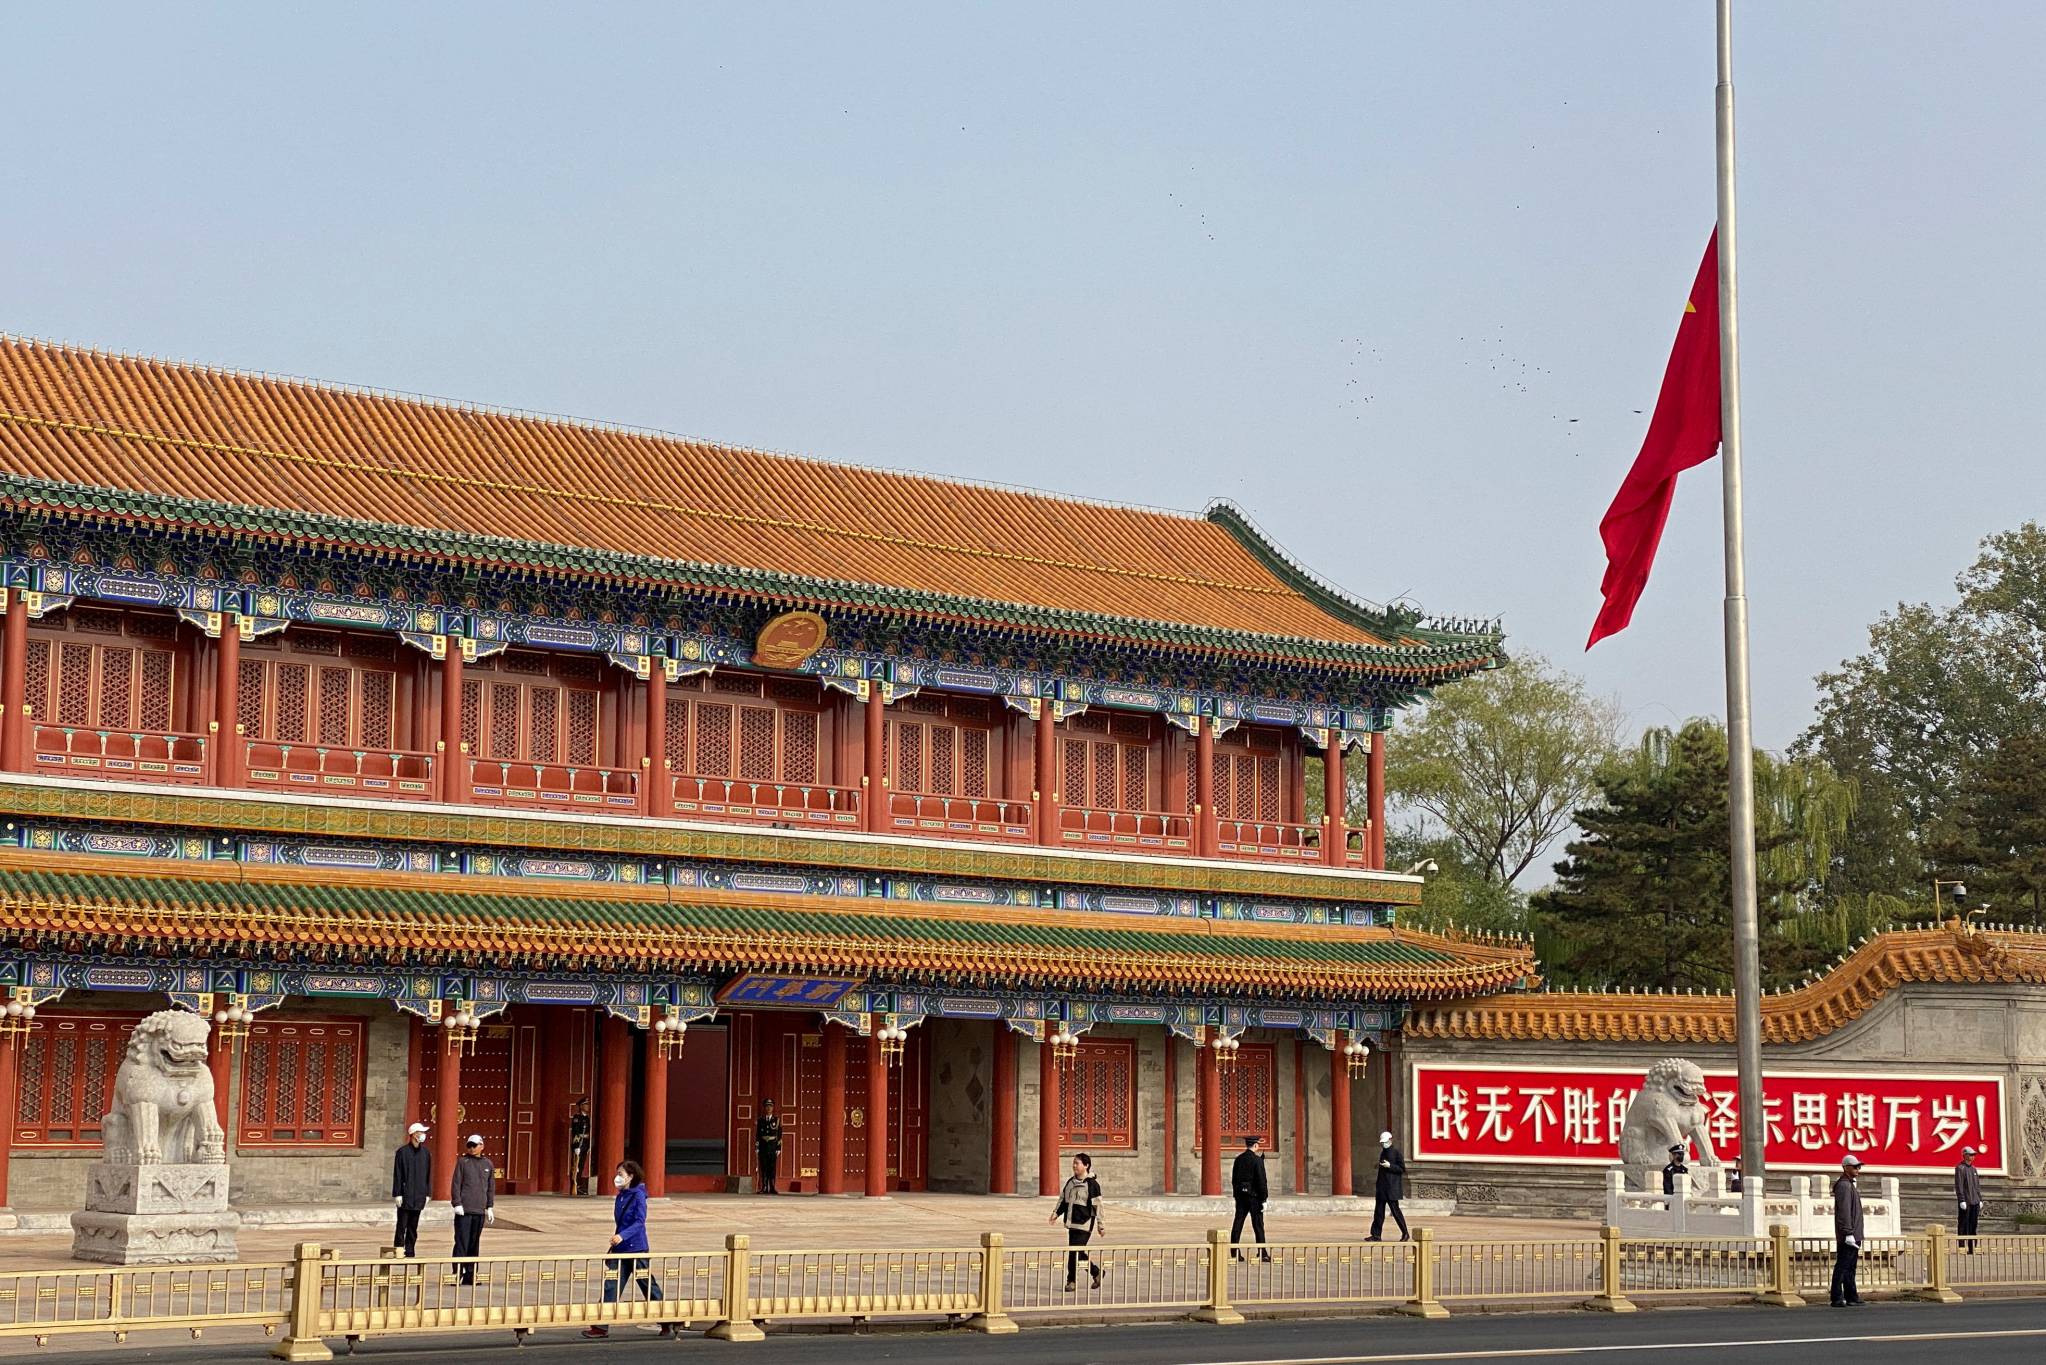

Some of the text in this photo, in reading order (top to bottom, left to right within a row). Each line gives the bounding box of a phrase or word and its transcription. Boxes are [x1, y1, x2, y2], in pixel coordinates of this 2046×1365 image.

[1431, 1084, 1988, 1153] 战无不胜的泽思想万岁!
